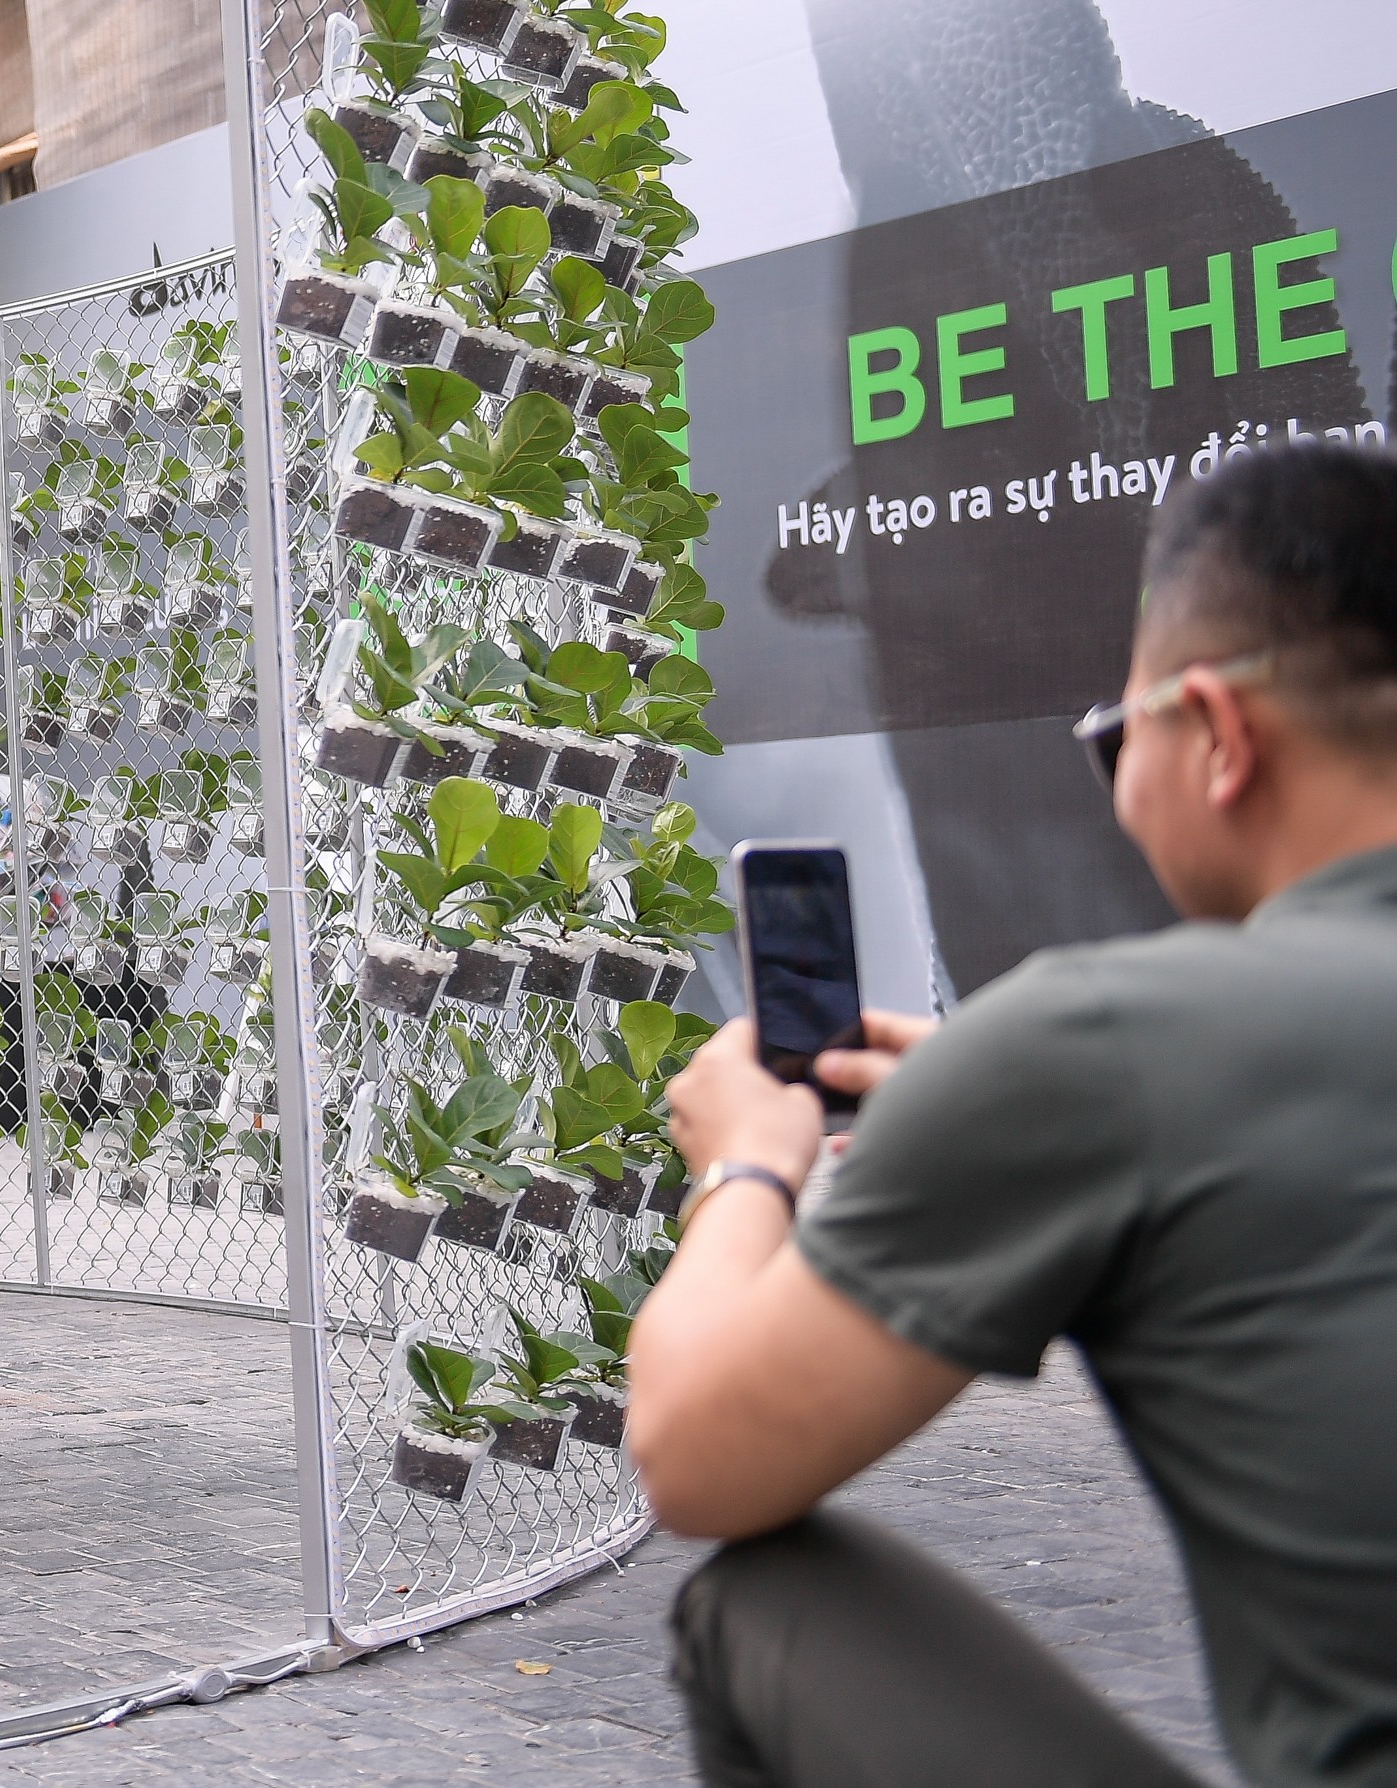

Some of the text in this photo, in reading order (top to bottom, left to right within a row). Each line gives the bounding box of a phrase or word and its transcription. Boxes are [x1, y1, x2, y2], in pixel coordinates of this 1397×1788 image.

[849, 303, 1015, 445] BE
[1052, 228, 1346, 402] THE
[778, 502, 857, 555] Hãy
[867, 490, 936, 545] tạo
[950, 484, 991, 522] ra
[1006, 465, 1057, 523] sự
[1069, 452, 1175, 506] thay
